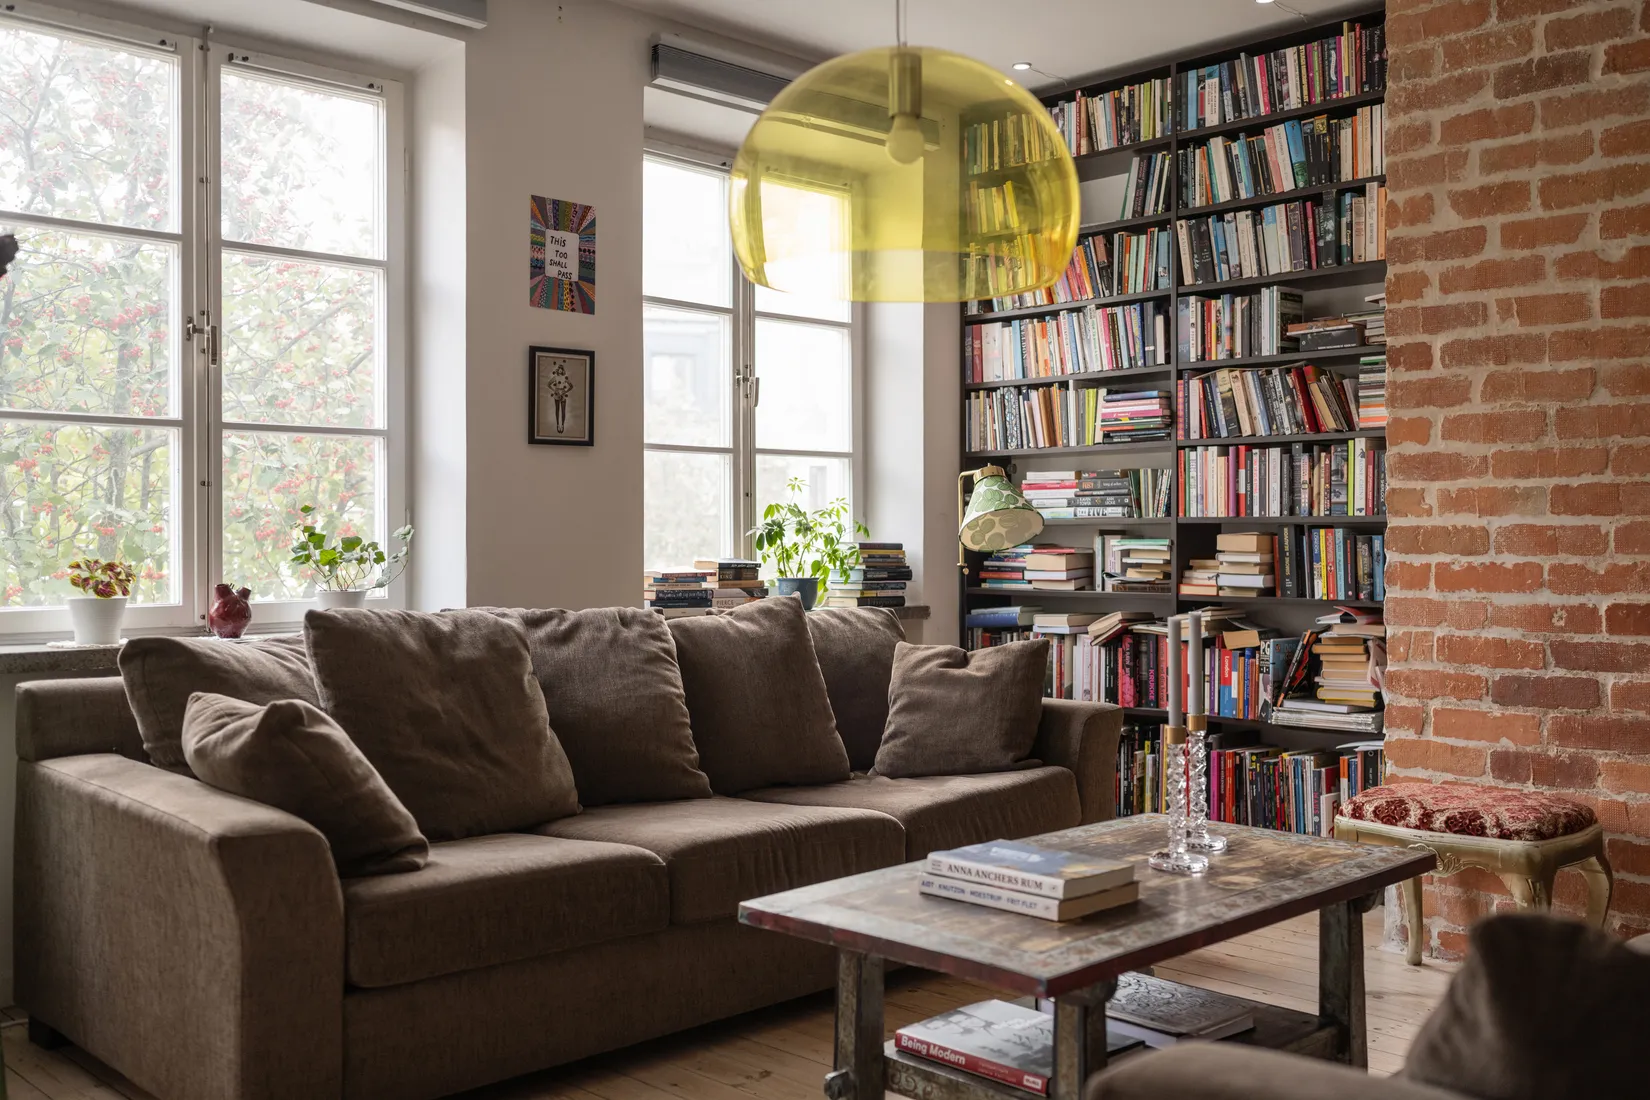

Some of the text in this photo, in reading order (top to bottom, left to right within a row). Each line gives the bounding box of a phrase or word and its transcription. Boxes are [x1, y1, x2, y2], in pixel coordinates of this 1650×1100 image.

[555, 250, 568, 260] TOO
[549, 259, 568, 269] SHALL
[558, 270, 572, 280] PASS
[1088, 507, 1107, 516] FIVE
[947, 864, 972, 876] ANNA
[973, 868, 1019, 884] ANCHERS
[1020, 878, 1043, 890] RUM
[901, 1036, 966, 1065] Being Modern
